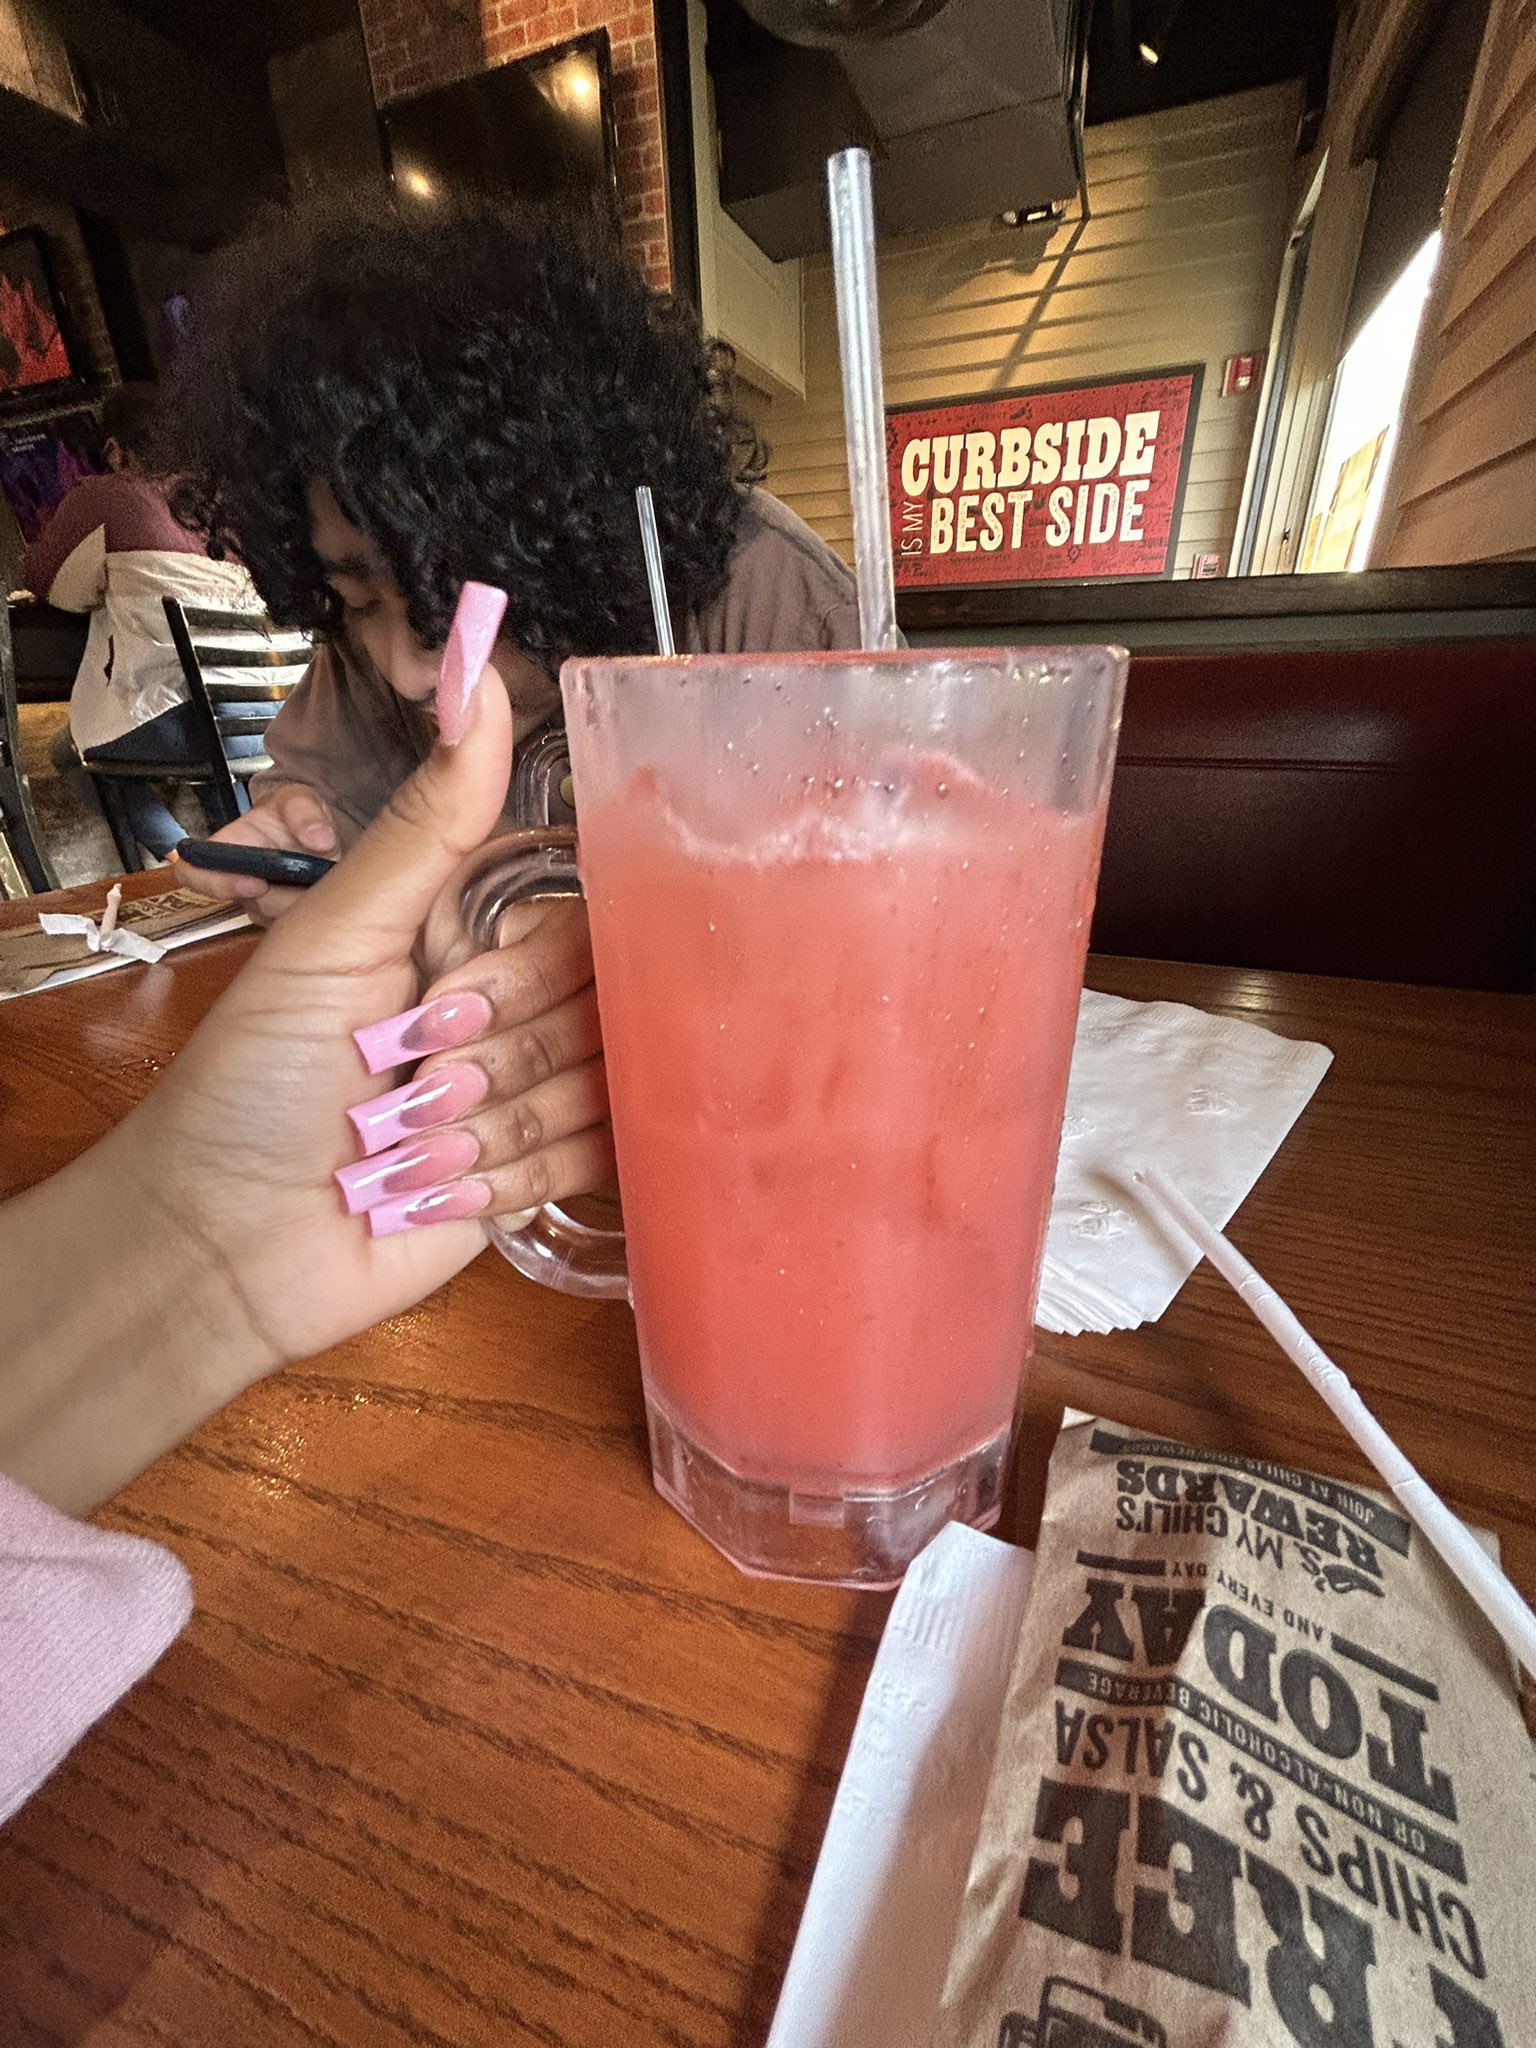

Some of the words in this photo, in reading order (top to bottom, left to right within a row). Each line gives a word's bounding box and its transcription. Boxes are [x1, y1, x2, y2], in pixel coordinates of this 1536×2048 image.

[902, 411, 1160, 496] CURBSIDE
[901, 501, 923, 532] MY
[930, 490, 1033, 554] BEST
[1046, 480, 1151, 547] SIDE
[901, 539, 923, 556] IS
[1116, 1495, 1229, 1539] CHILI'S
[1306, 1481, 1335, 1502] AT
[1338, 1492, 1376, 1525] JOIN
[1116, 1459, 1384, 1580] REWARDS
[1236, 1517, 1285, 1570] MY
[1171, 1561, 1208, 1579] DAY
[1216, 1567, 1275, 1620] EVERY
[1283, 1608, 1324, 1643] AND
[1062, 1578, 1458, 1823] TODAY
[1087, 1672, 1190, 1714] BEVERAGE
[1054, 1699, 1209, 1802] SALSA
[1200, 1698, 1384, 1829] NON-ALCOHOLIC
[1230, 1761, 1275, 1841] &
[1395, 1816, 1427, 1854] OR
[1296, 1804, 1486, 1979] CHIPS
